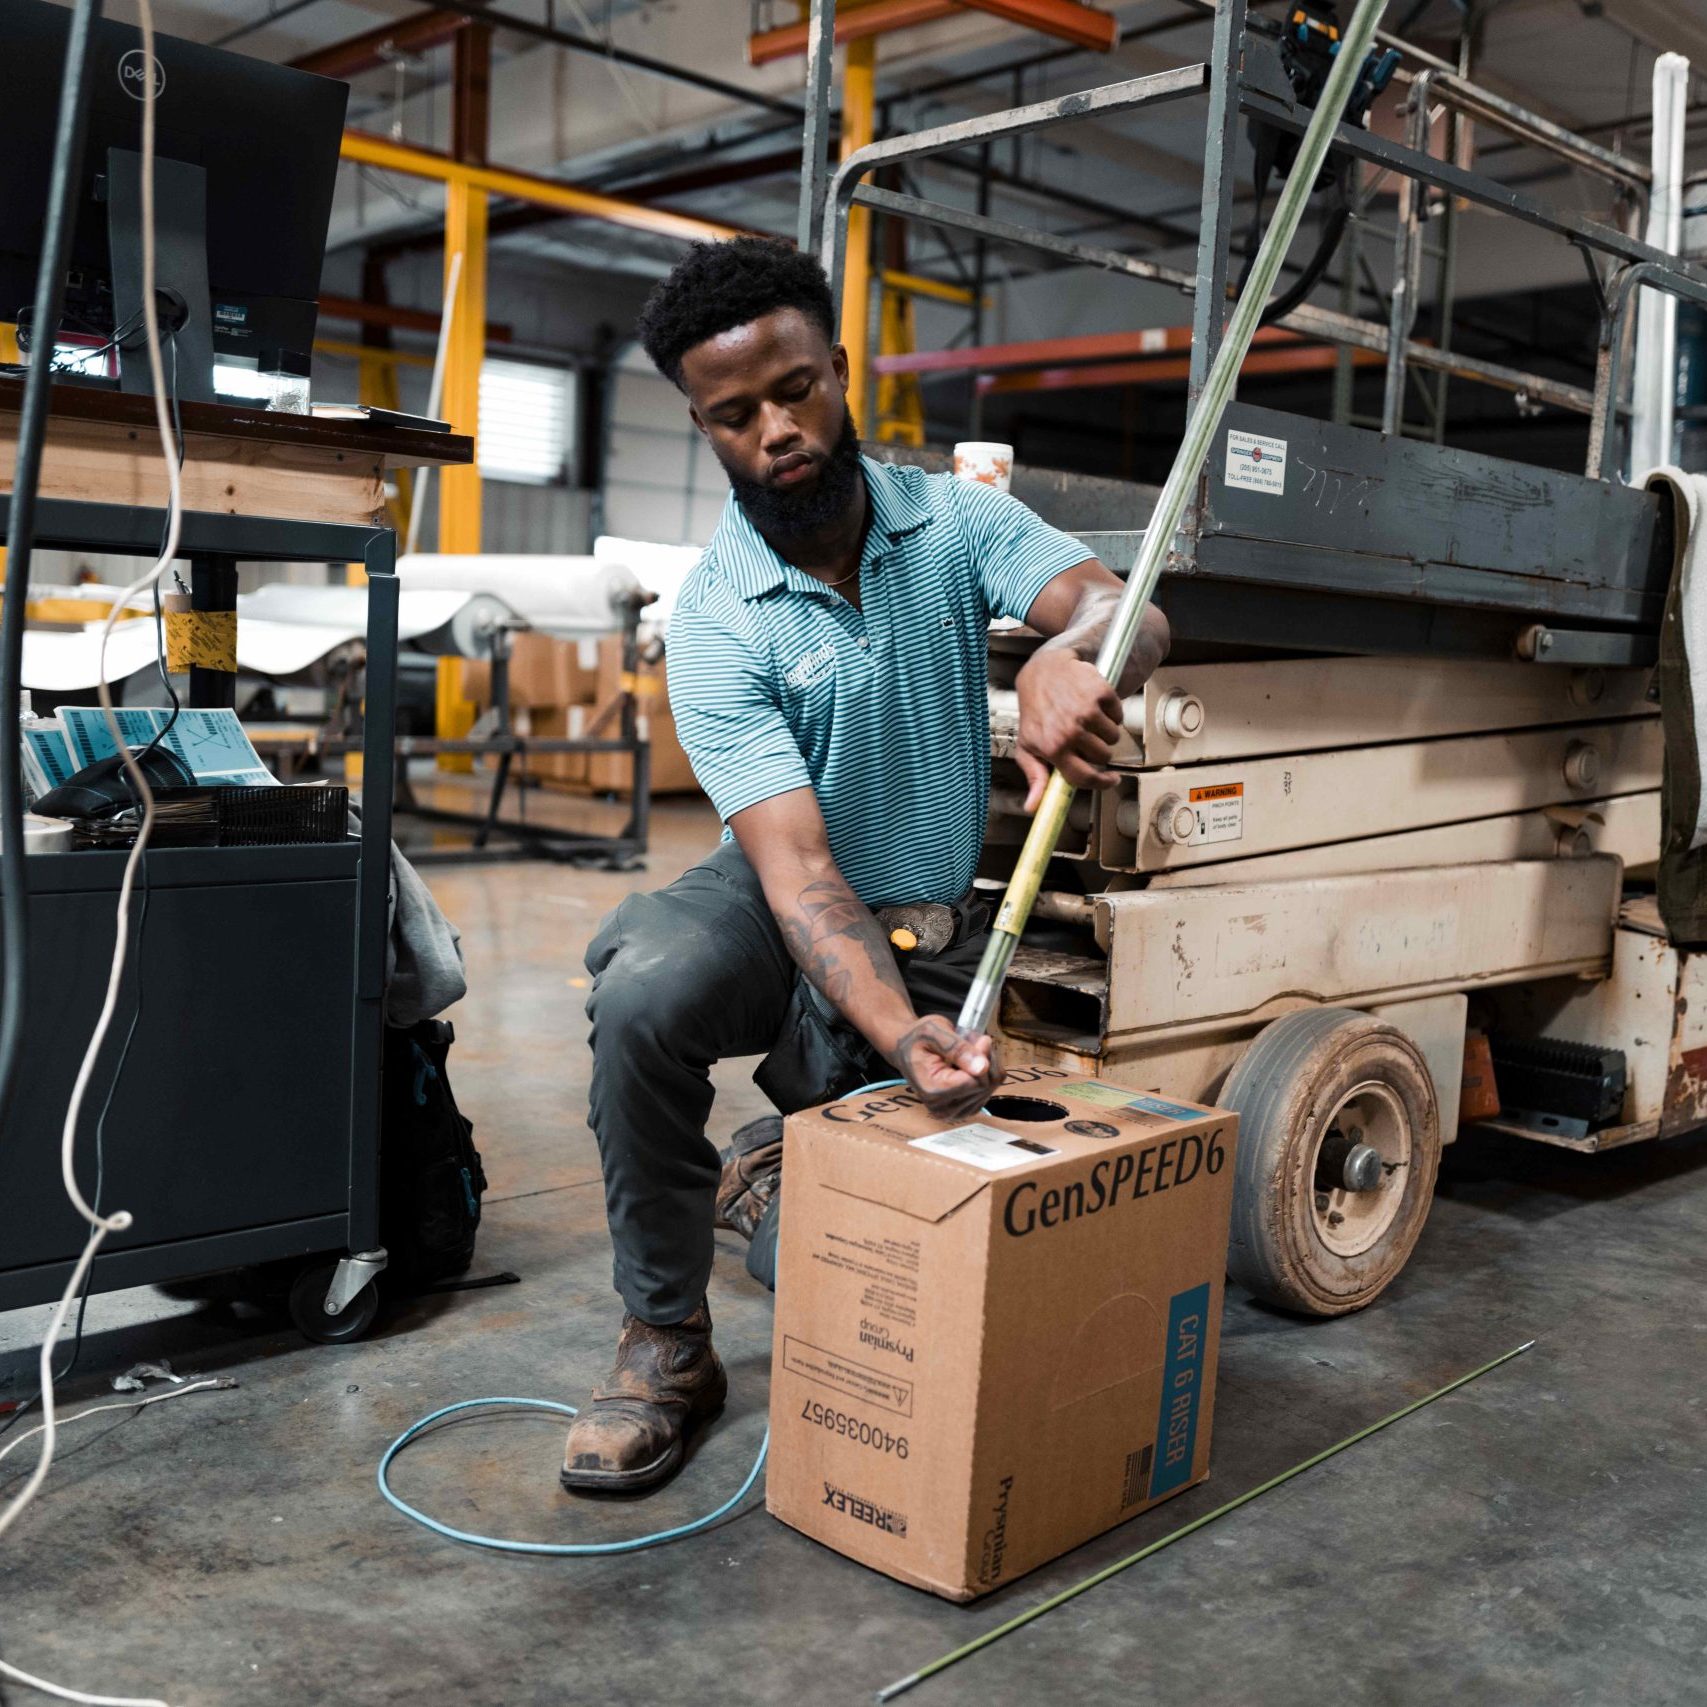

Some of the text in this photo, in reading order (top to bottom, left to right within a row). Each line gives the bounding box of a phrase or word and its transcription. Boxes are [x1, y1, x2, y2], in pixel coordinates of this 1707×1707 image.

[124, 65, 160, 86] DEL
[1204, 786, 1237, 798] WARNING
[859, 1331, 914, 1362] Prysmian
[860, 1317, 890, 1339] Group
[1165, 1314, 1199, 1467] CAT 6 RISER
[801, 1400, 909, 1459] 940035957
[822, 1486, 888, 1533] REELEX
[991, 1475, 1013, 1579] Prysmian
